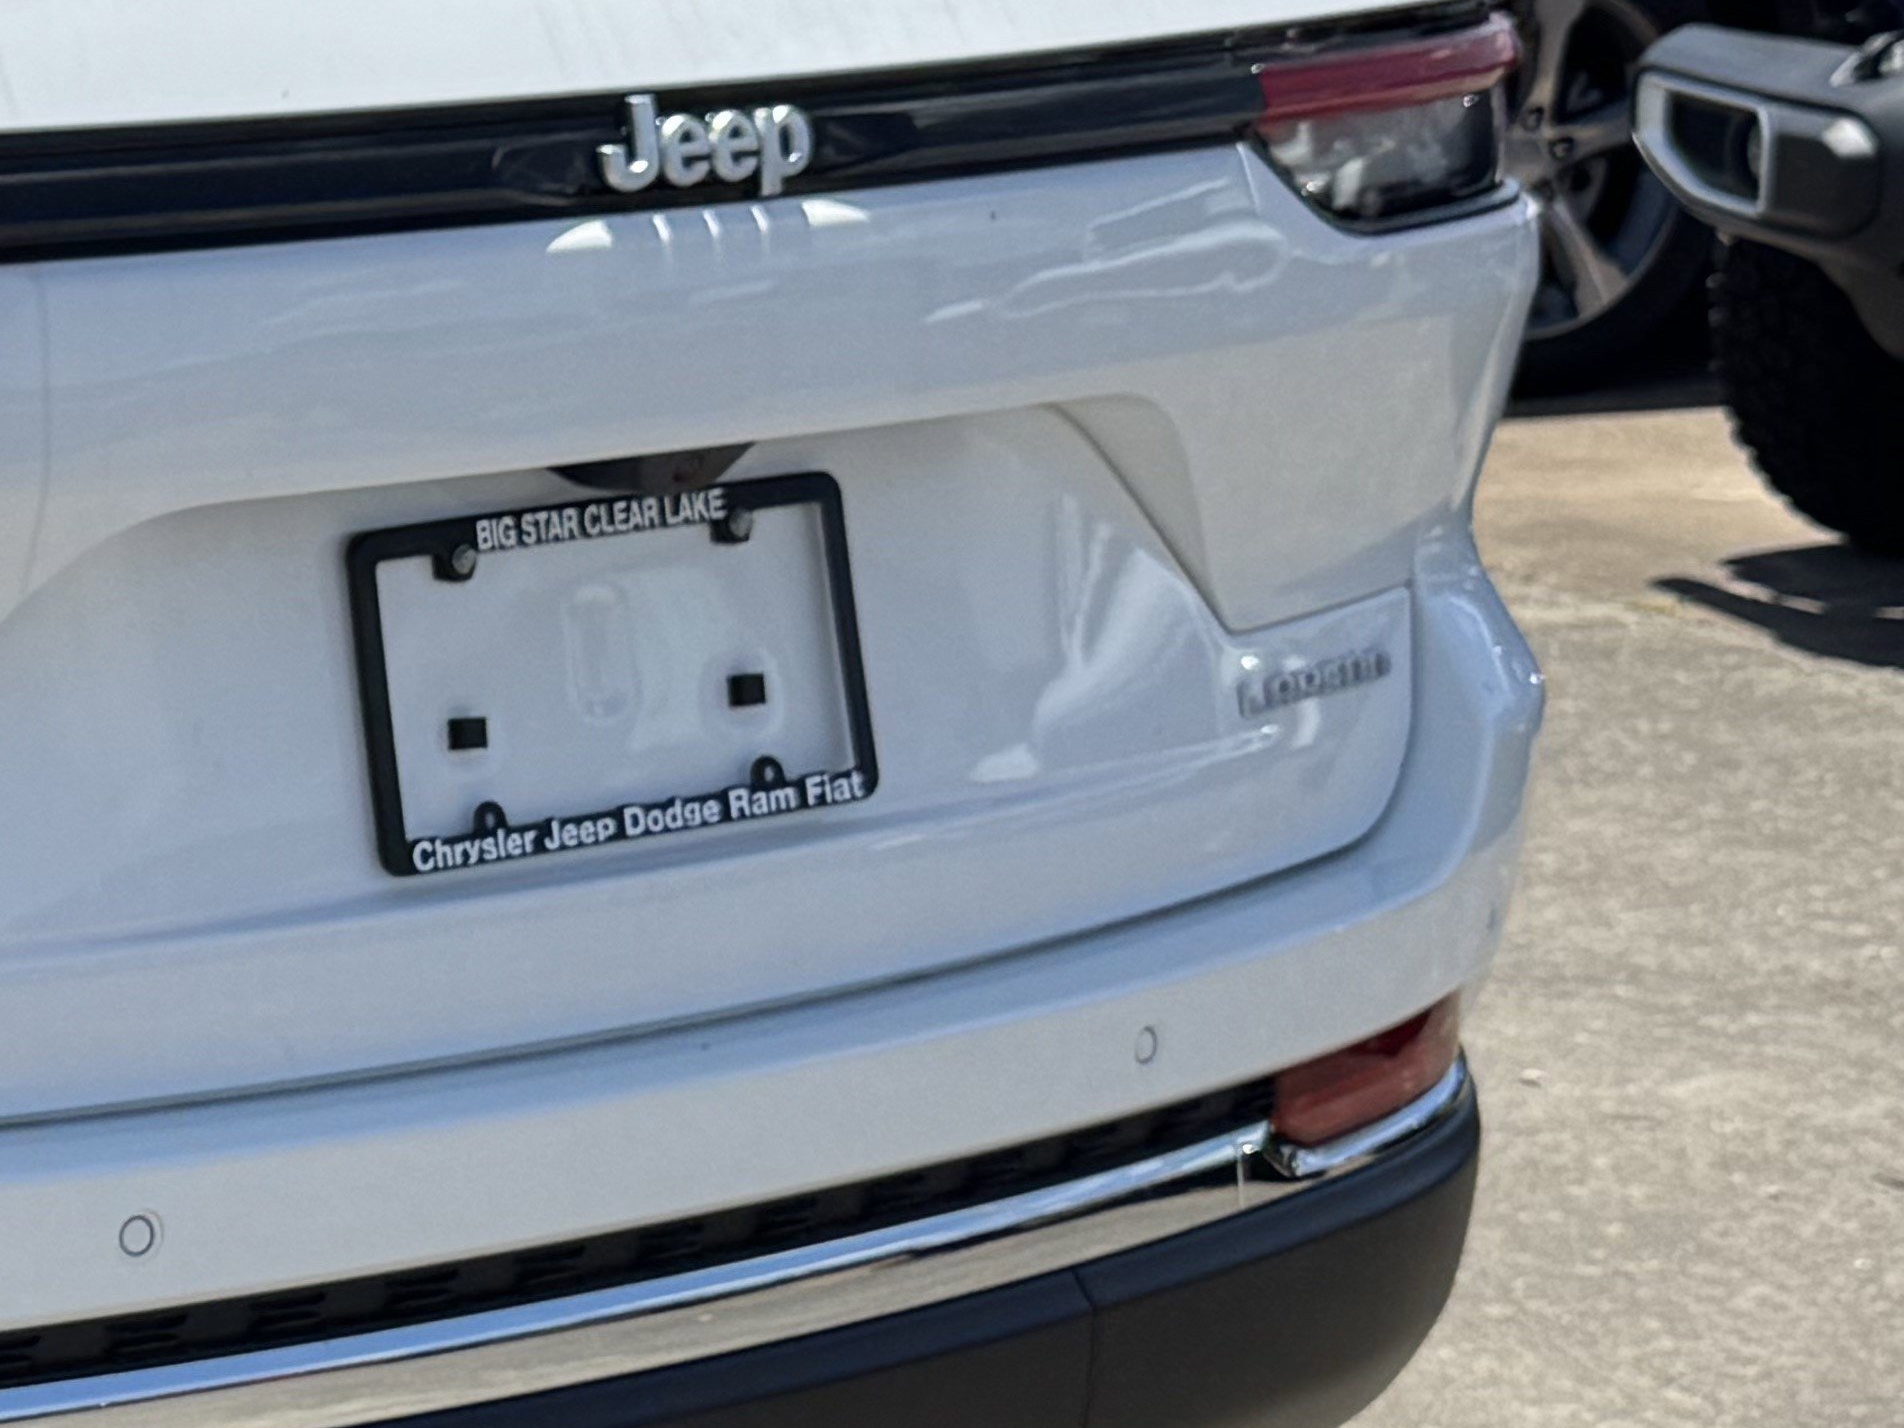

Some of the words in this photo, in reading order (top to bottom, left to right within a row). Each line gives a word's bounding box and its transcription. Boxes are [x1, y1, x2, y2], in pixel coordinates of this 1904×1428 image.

[596, 92, 814, 197] Jeep
[476, 515, 517, 551] BIG
[521, 507, 580, 545] STAR
[583, 496, 660, 537] CLEAR
[664, 488, 728, 523] LAKE
[412, 828, 539, 873] Chrysler
[544, 819, 617, 851] Jeep
[623, 798, 722, 837] Dodge
[728, 786, 801, 820] Ram
[805, 770, 864, 806] Fiat
